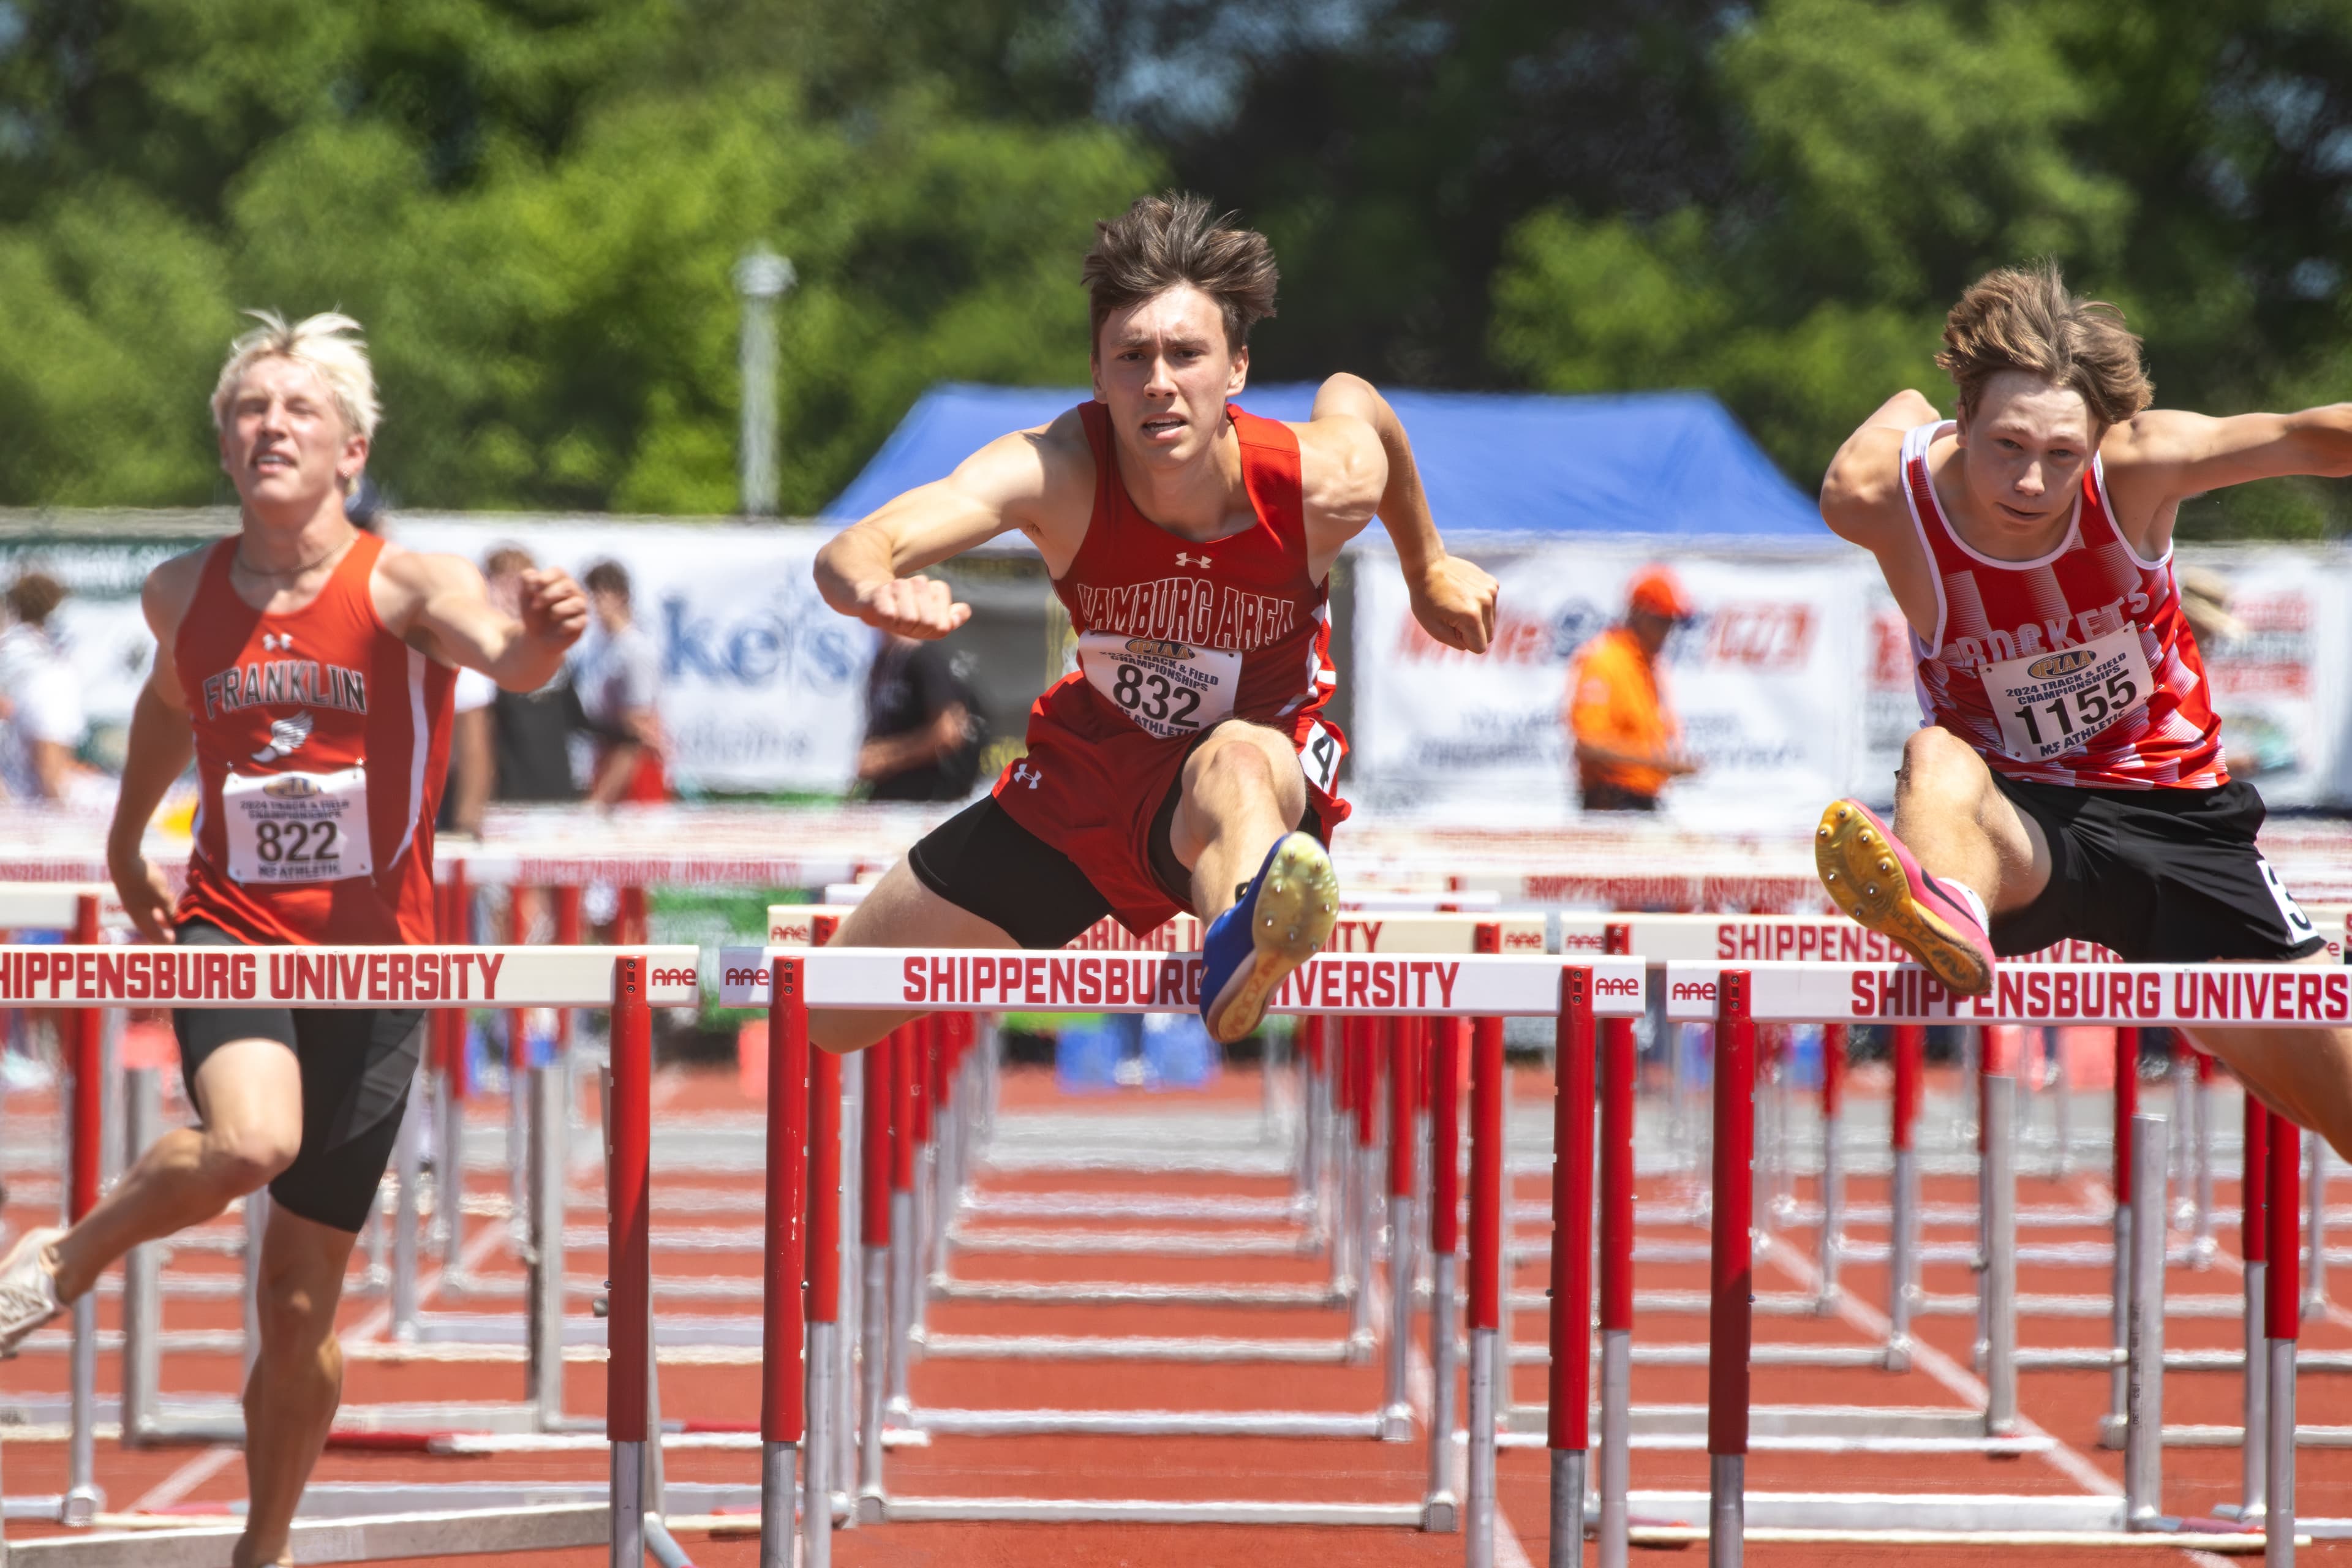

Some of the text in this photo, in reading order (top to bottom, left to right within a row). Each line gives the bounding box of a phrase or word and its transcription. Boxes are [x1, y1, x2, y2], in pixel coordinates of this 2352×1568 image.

[1956, 584, 2149, 666] ROCKETS
[1136, 640, 1192, 660] PIAA
[1137, 655, 1177, 669] TRACK
[1179, 665, 1187, 674] &
[1189, 667, 1219, 686] FIELD
[2037, 650, 2094, 677] PIAA
[203, 659, 368, 721] FRANKLIN
[1110, 655, 1209, 692] CHAMPIONSHIPS
[1112, 664, 1201, 728] 832
[2005, 652, 2127, 697] 2024 TRACK & FIELD
[2018, 665, 2121, 705] CHAMPIONSHIPS
[2014, 669, 2137, 745] 1155
[2064, 709, 2125, 751] ATHLETIC
[255, 820, 340, 862] 822
[270, 952, 505, 1000] UNIVERSITY
[903, 956, 1201, 1005] SHIPPENSBURG
[1270, 960, 1460, 1008] IVERSITY
[2174, 973, 2352, 1020] UNIVERS
